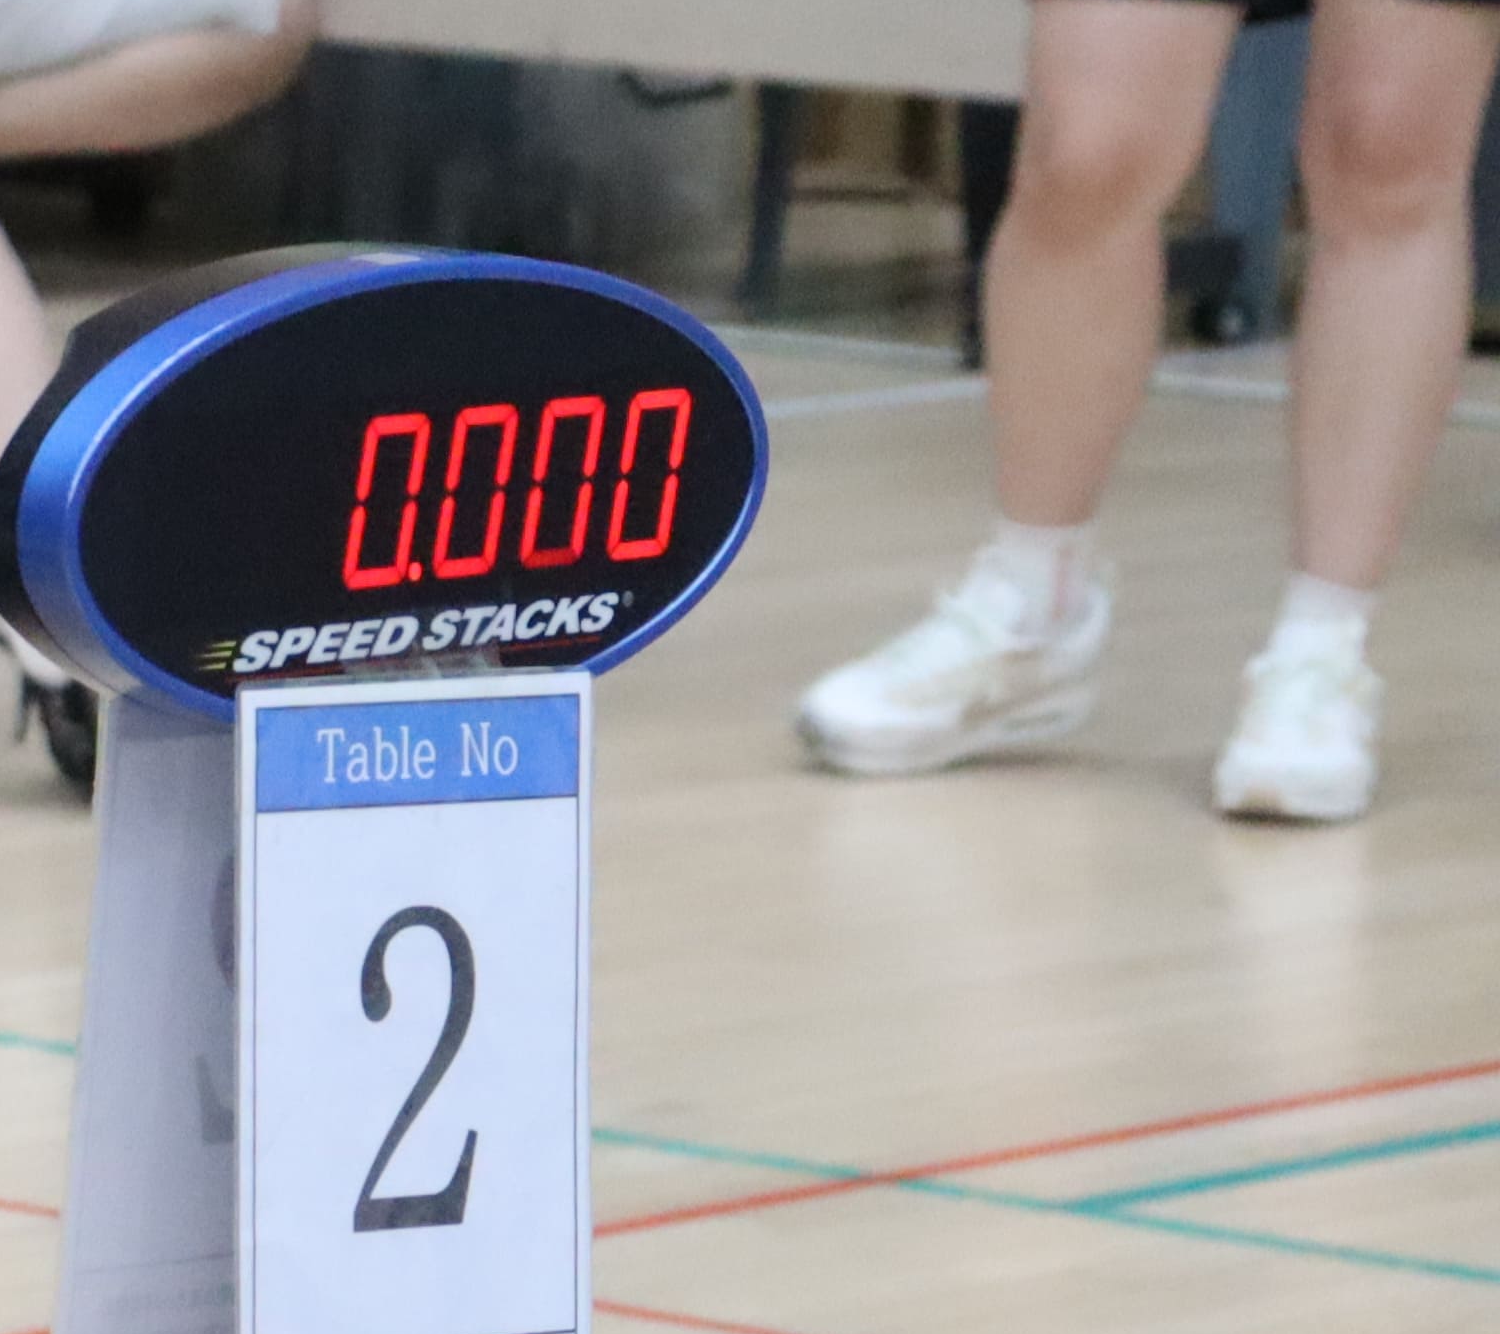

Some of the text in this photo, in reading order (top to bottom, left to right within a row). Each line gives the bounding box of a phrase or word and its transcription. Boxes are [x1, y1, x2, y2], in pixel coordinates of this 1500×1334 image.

[343, 387, 693, 591] 0.000
[232, 591, 620, 673] SPEED STACKS
[316, 721, 520, 784] Table No
[353, 905, 478, 1233] 2
